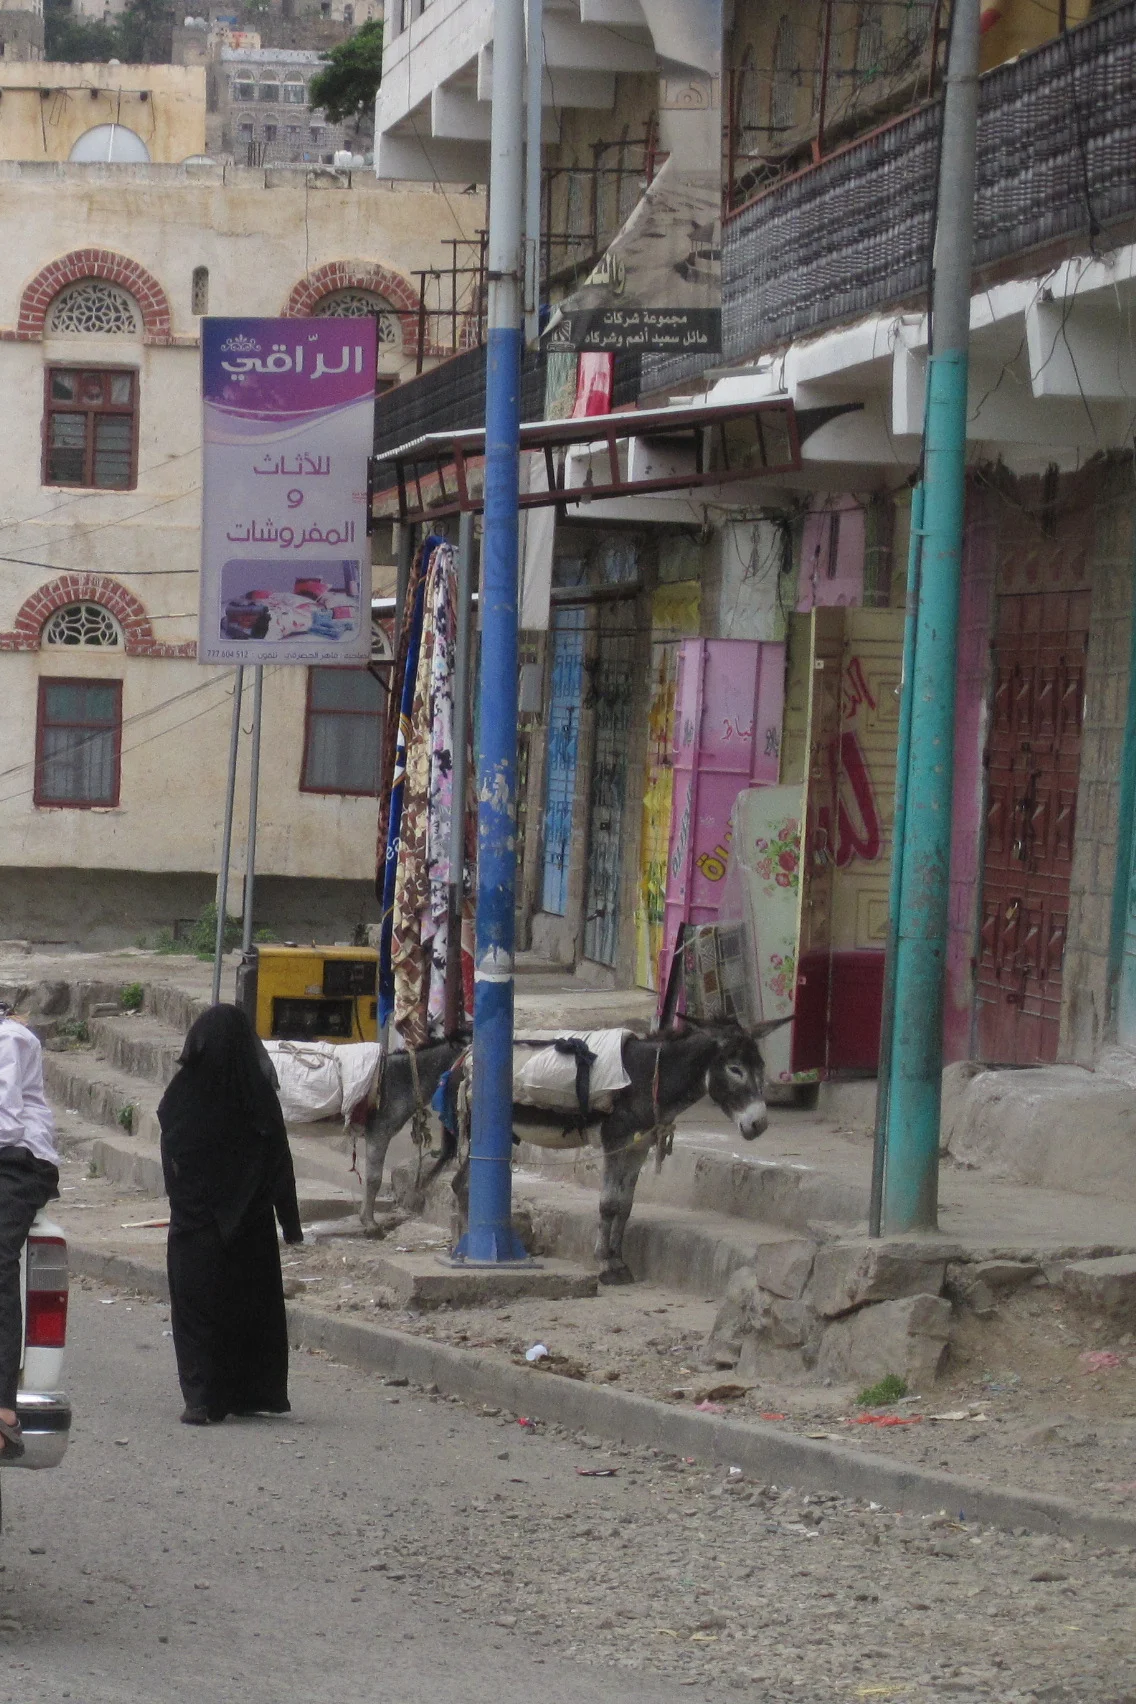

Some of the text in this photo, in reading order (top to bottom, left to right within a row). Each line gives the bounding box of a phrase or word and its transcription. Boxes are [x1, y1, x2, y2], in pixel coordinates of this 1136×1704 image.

[603, 311, 688, 328] مجموعة شركات
[584, 330, 623, 348] وشركاه
[625, 327, 649, 348] أنعم
[651, 332, 680, 347] سعيد
[682, 329, 708, 347] هائل
[252, 452, 331, 476] للأثاث
[286, 487, 305, 509] و
[225, 518, 356, 549] المفروشات
